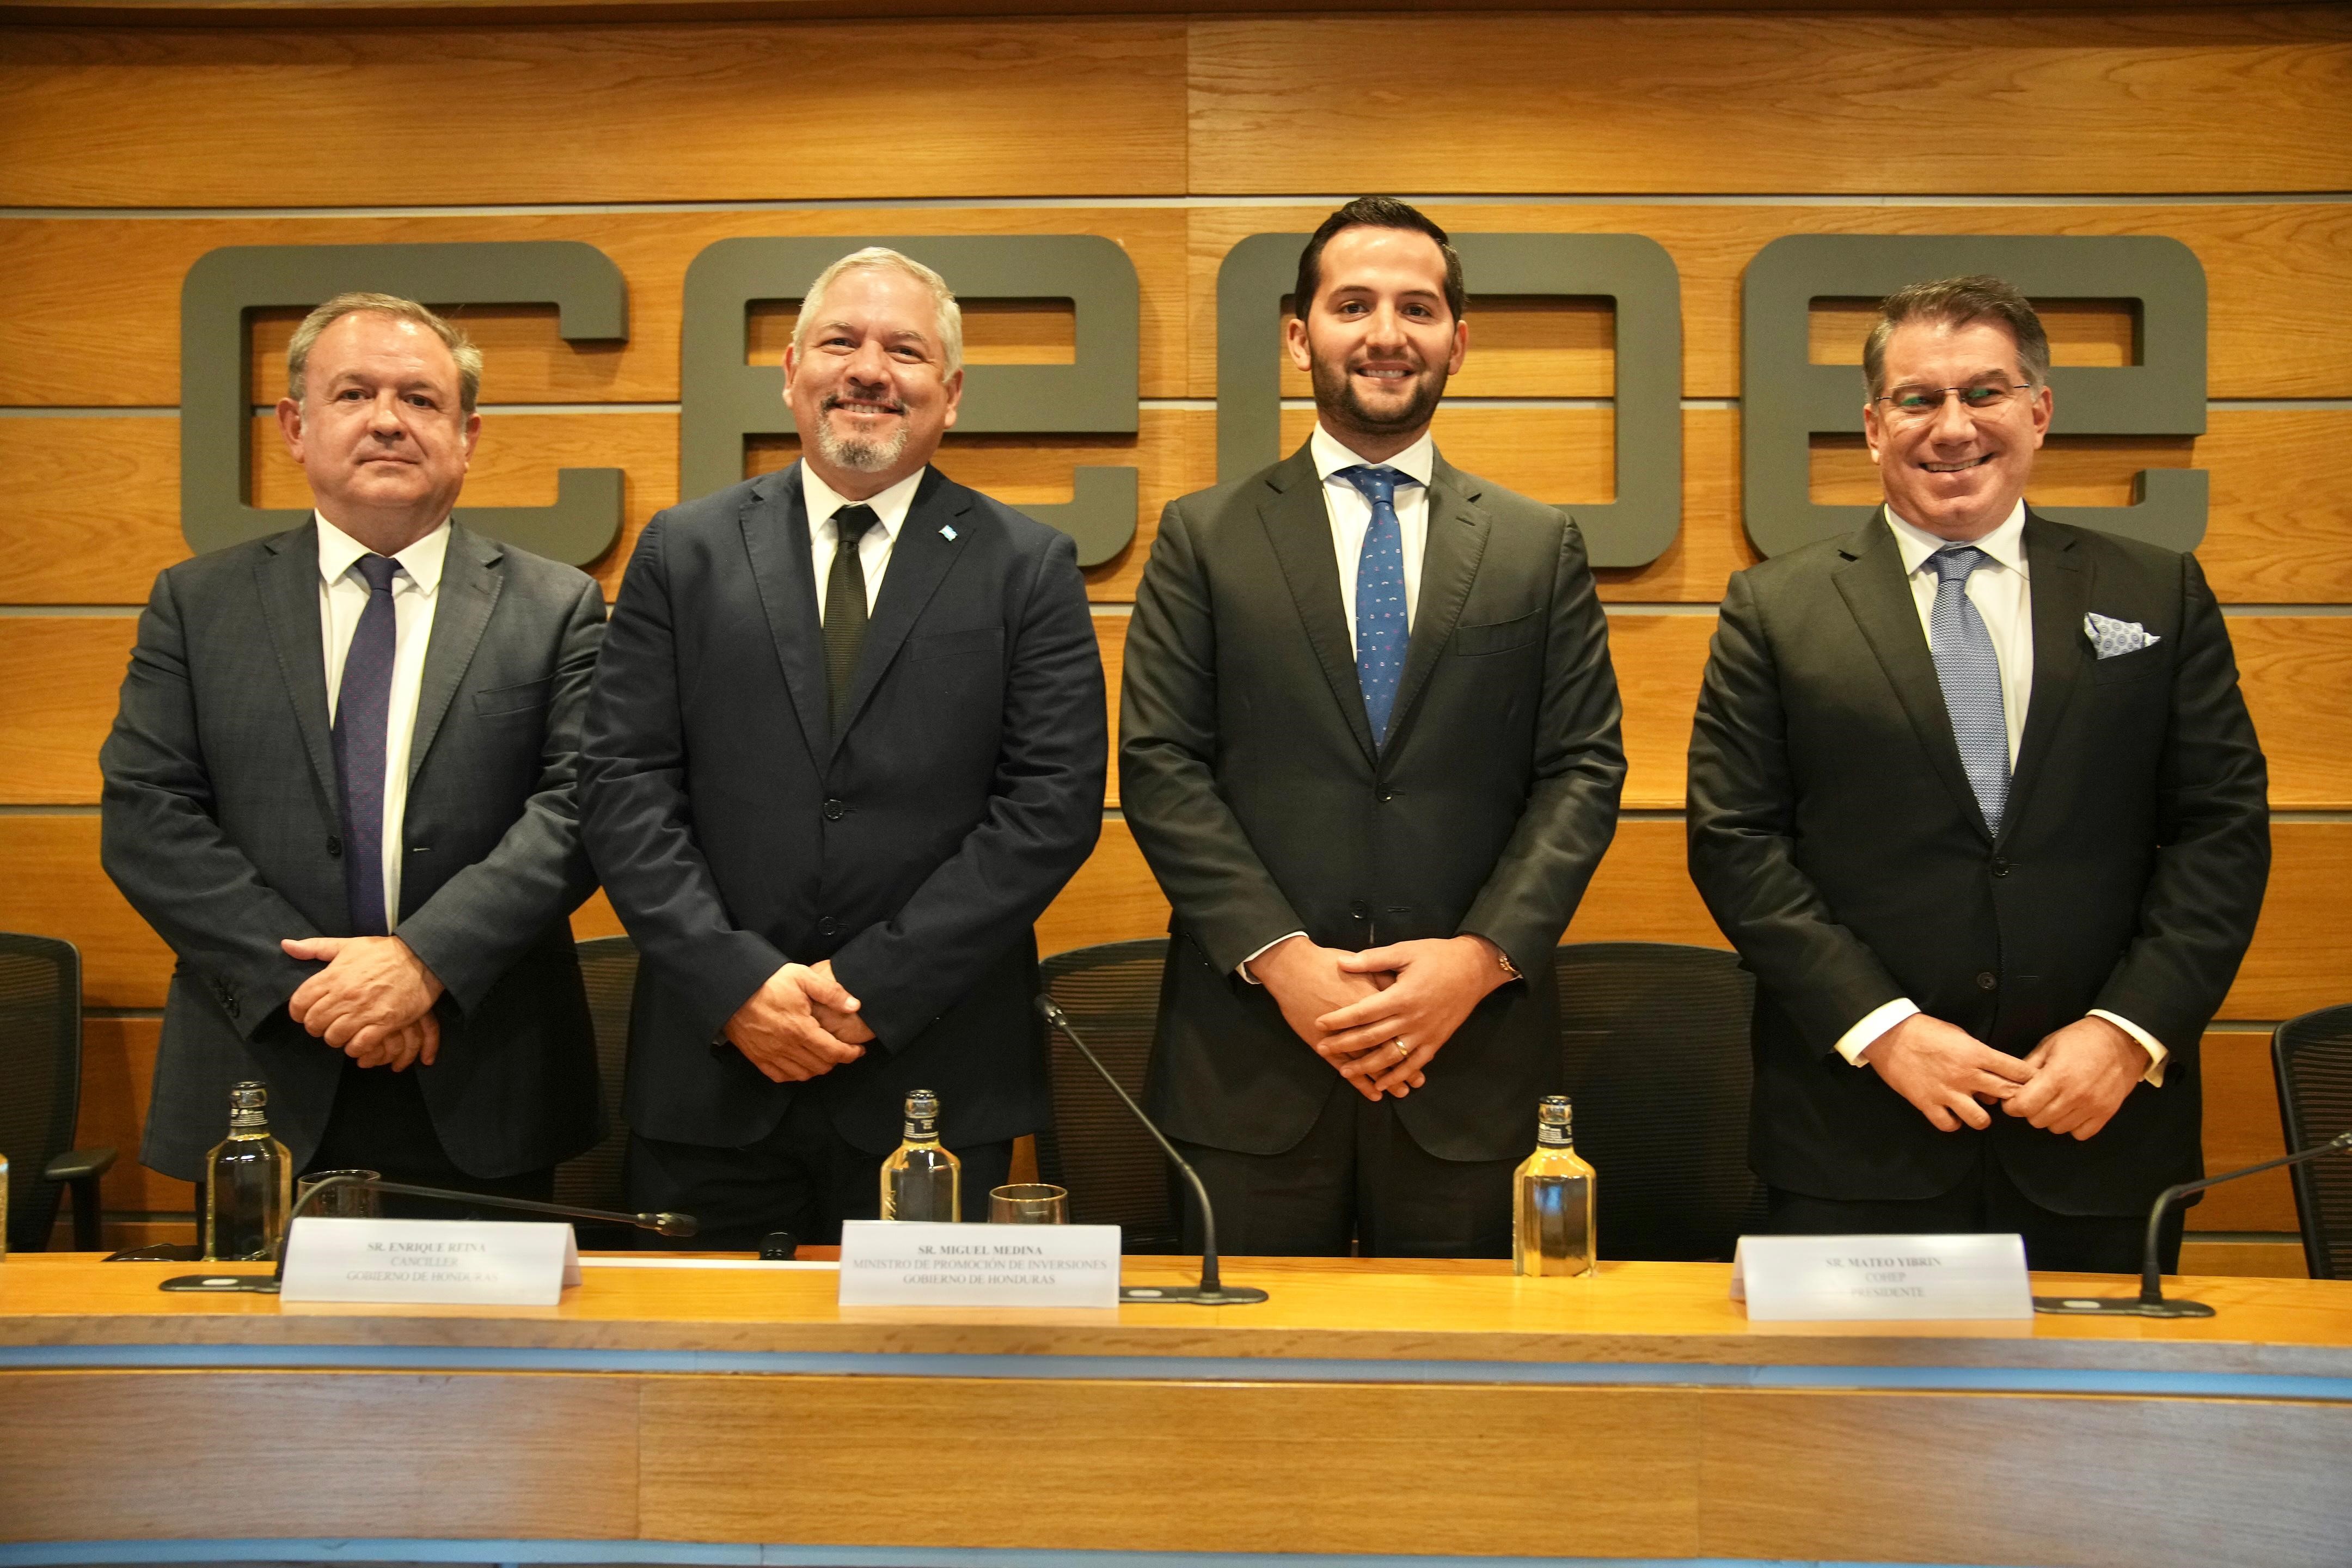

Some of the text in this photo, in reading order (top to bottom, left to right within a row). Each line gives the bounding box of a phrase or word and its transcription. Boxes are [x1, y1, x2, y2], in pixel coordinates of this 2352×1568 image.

[367, 1242, 385, 1252] SR.
[388, 1242, 444, 1254] ENRIQUE
[918, 1245, 1043, 1255] SR. MIGUEL MEDINA
[390, 1256, 458, 1267] CANCILLER
[853, 1256, 1107, 1270] MINISTRO DE PROMOCIÓN DE INVERSIONES
[1848, 1258, 1894, 1267] MATEO
[346, 1270, 409, 1281] GOBIERNO
[413, 1271, 429, 1282] DE
[903, 1274, 1055, 1285] GOBIERNO DE HONDURAS
